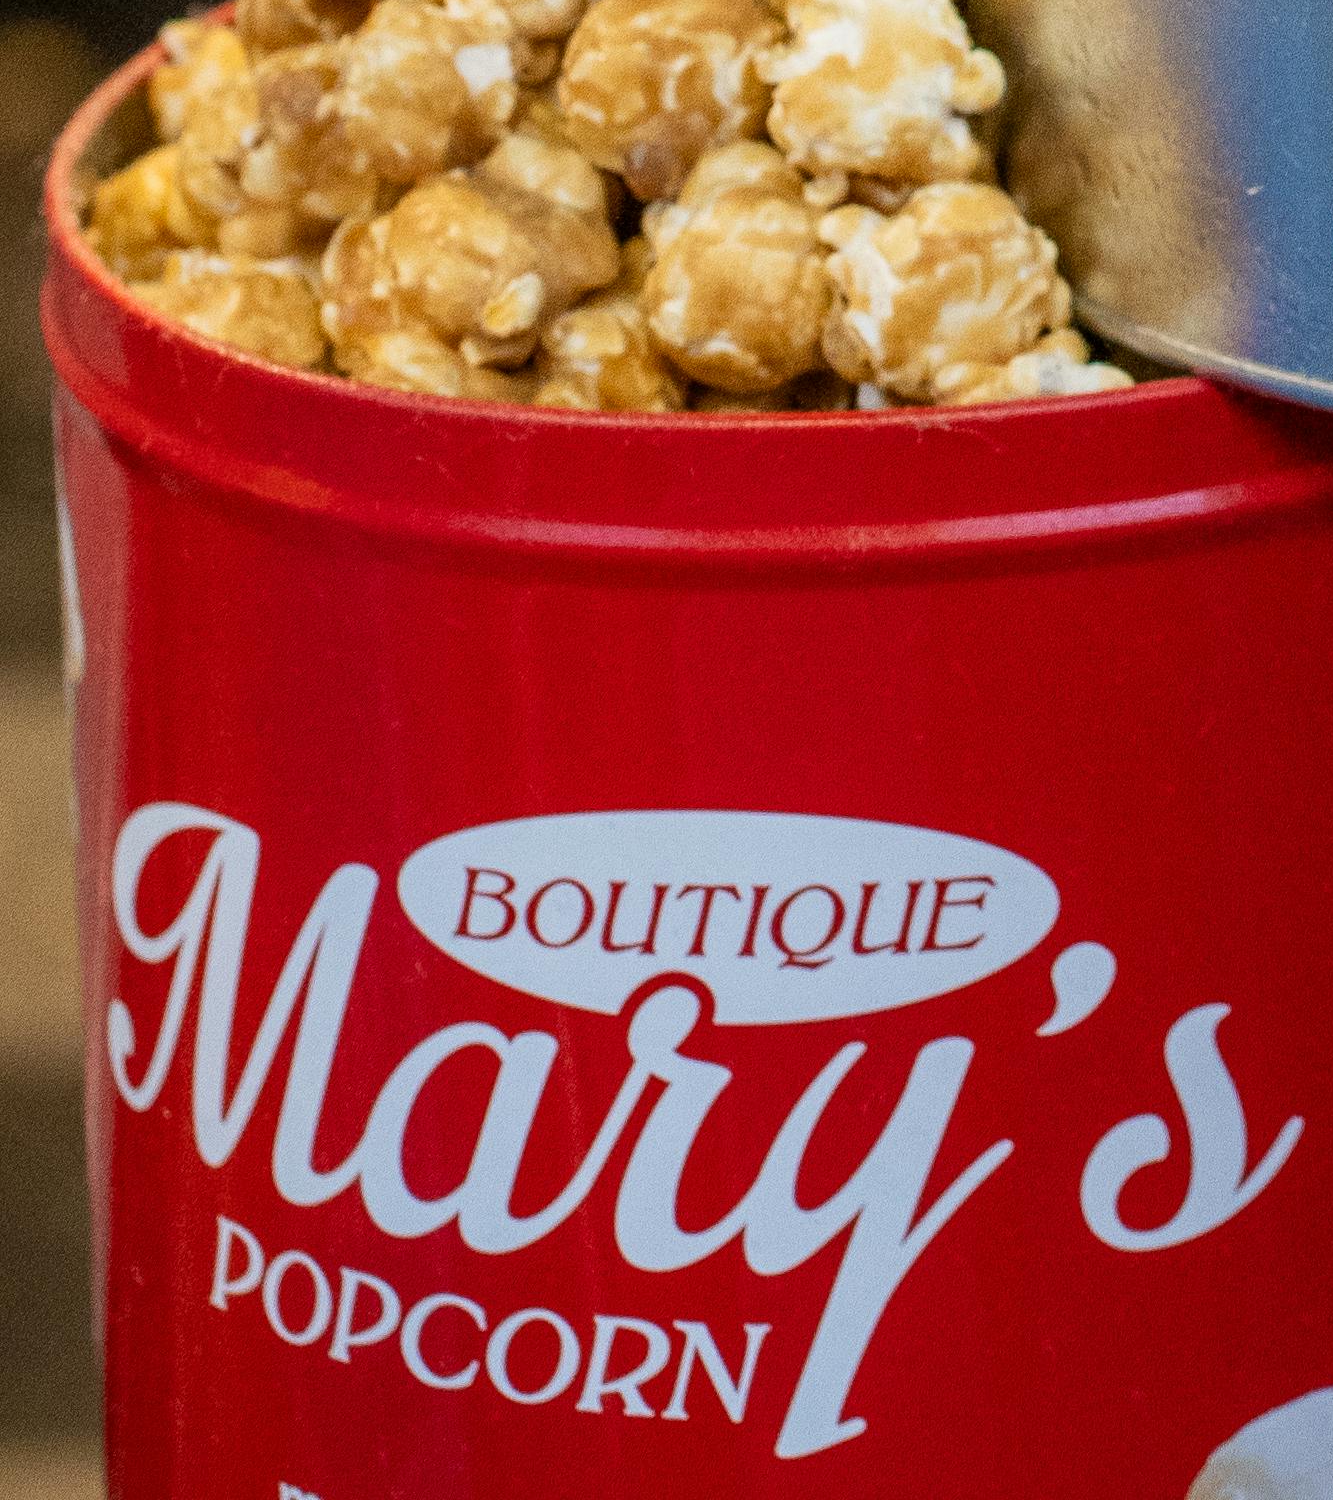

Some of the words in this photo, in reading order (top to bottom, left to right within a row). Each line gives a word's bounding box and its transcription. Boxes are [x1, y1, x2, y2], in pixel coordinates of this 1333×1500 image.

[453, 866, 998, 972] BOUTIQUE
[106, 800, 1306, 1460] Mary's
[208, 1213, 773, 1425] POPCORN
